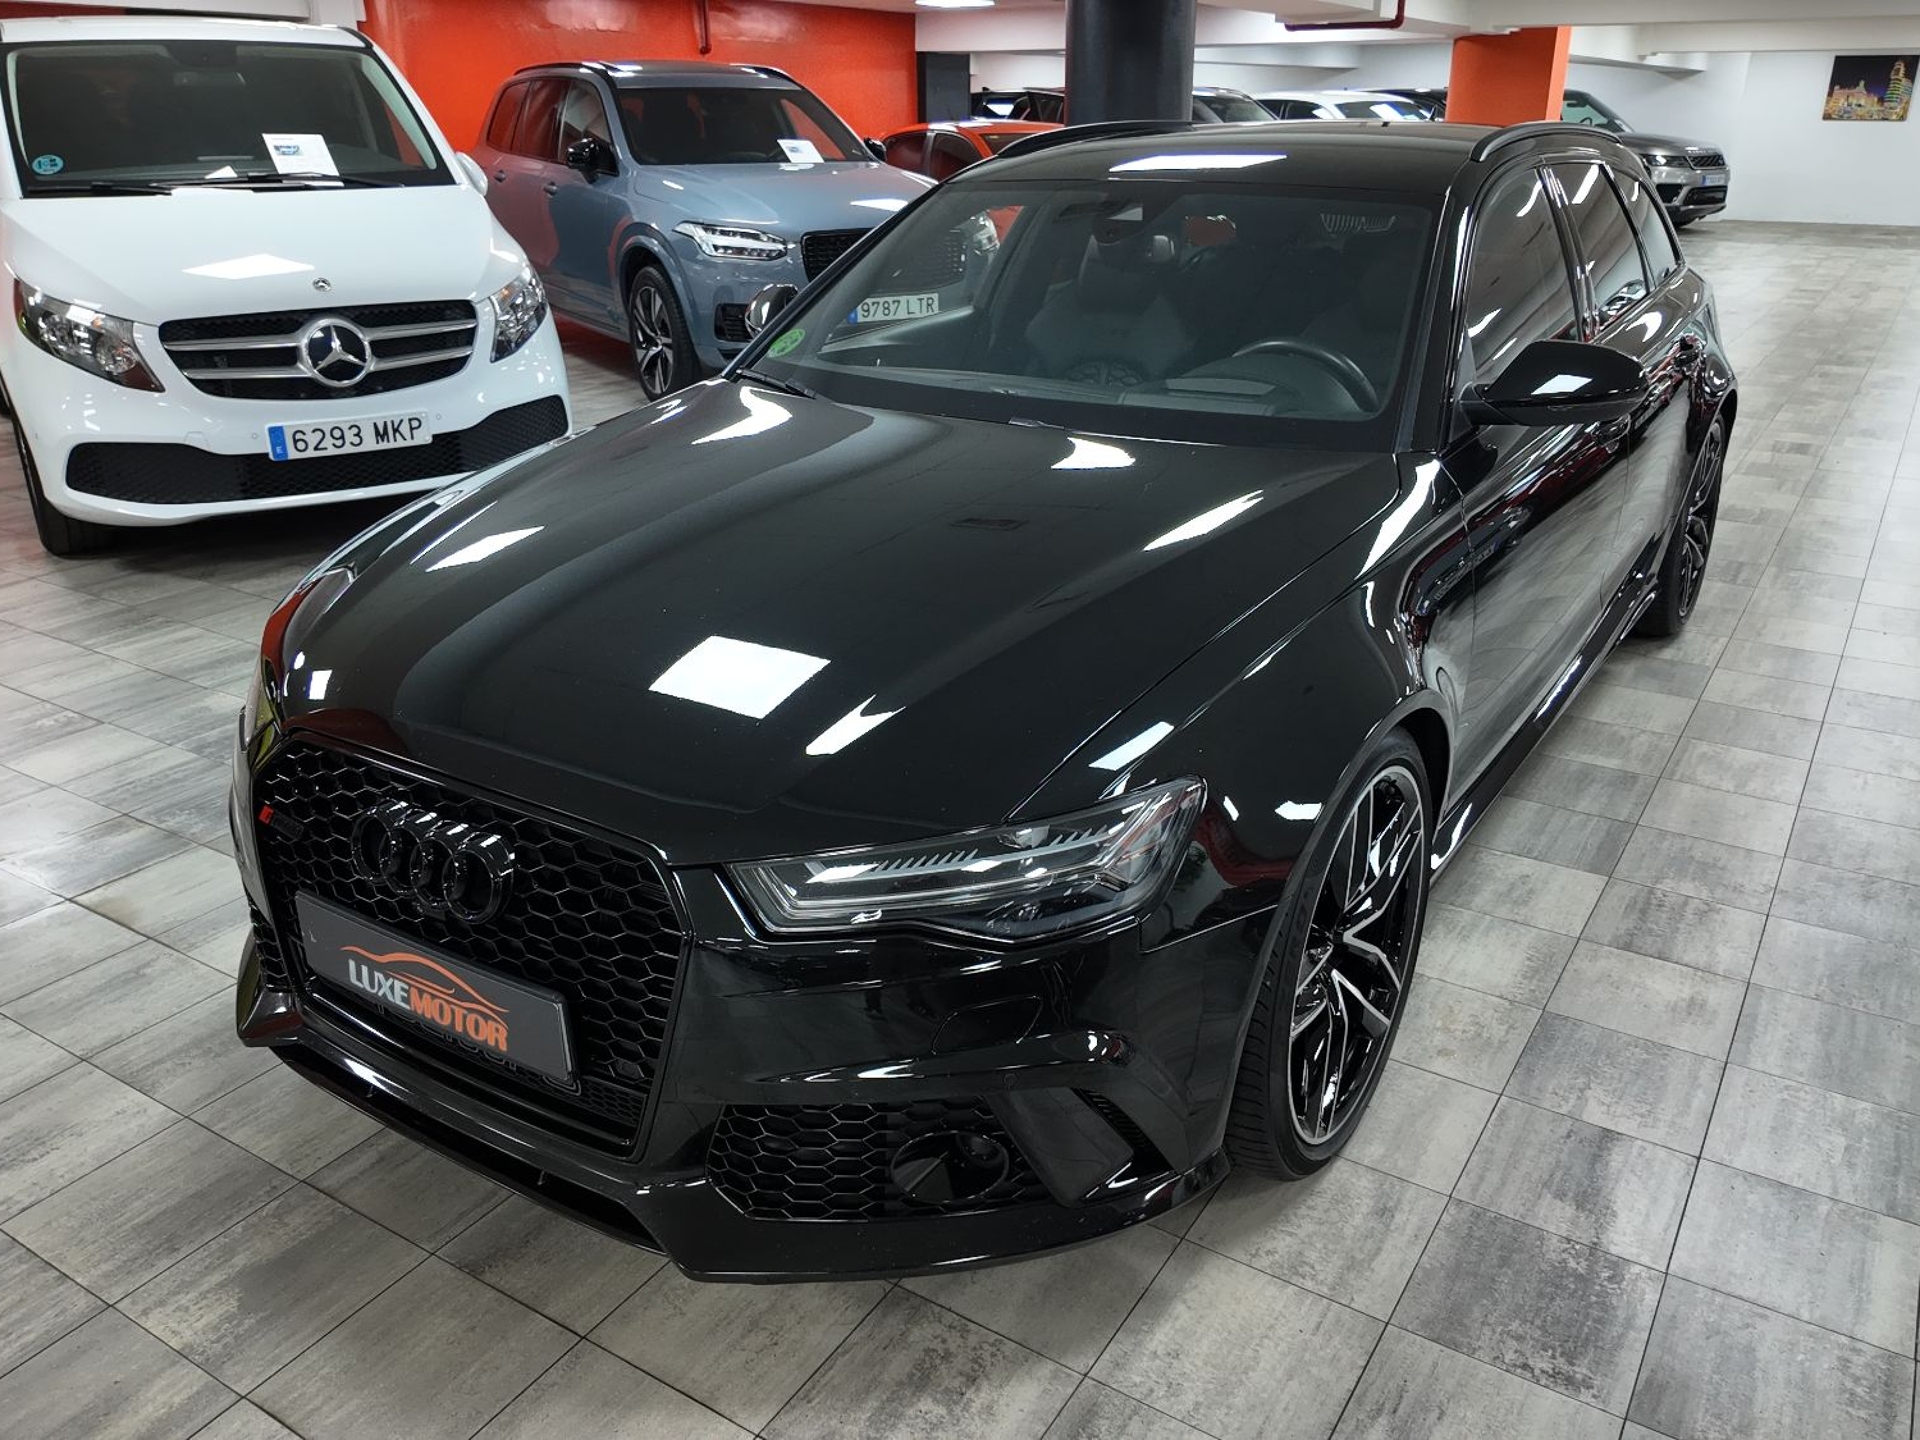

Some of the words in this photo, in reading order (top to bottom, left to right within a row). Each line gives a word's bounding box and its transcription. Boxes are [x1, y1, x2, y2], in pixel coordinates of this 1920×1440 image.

[860, 300, 901, 319] 9787
[906, 296, 935, 315] LTR
[291, 424, 364, 453] 6293
[373, 417, 422, 445] MKP
[348, 958, 508, 1052] LUXEMOTOR
